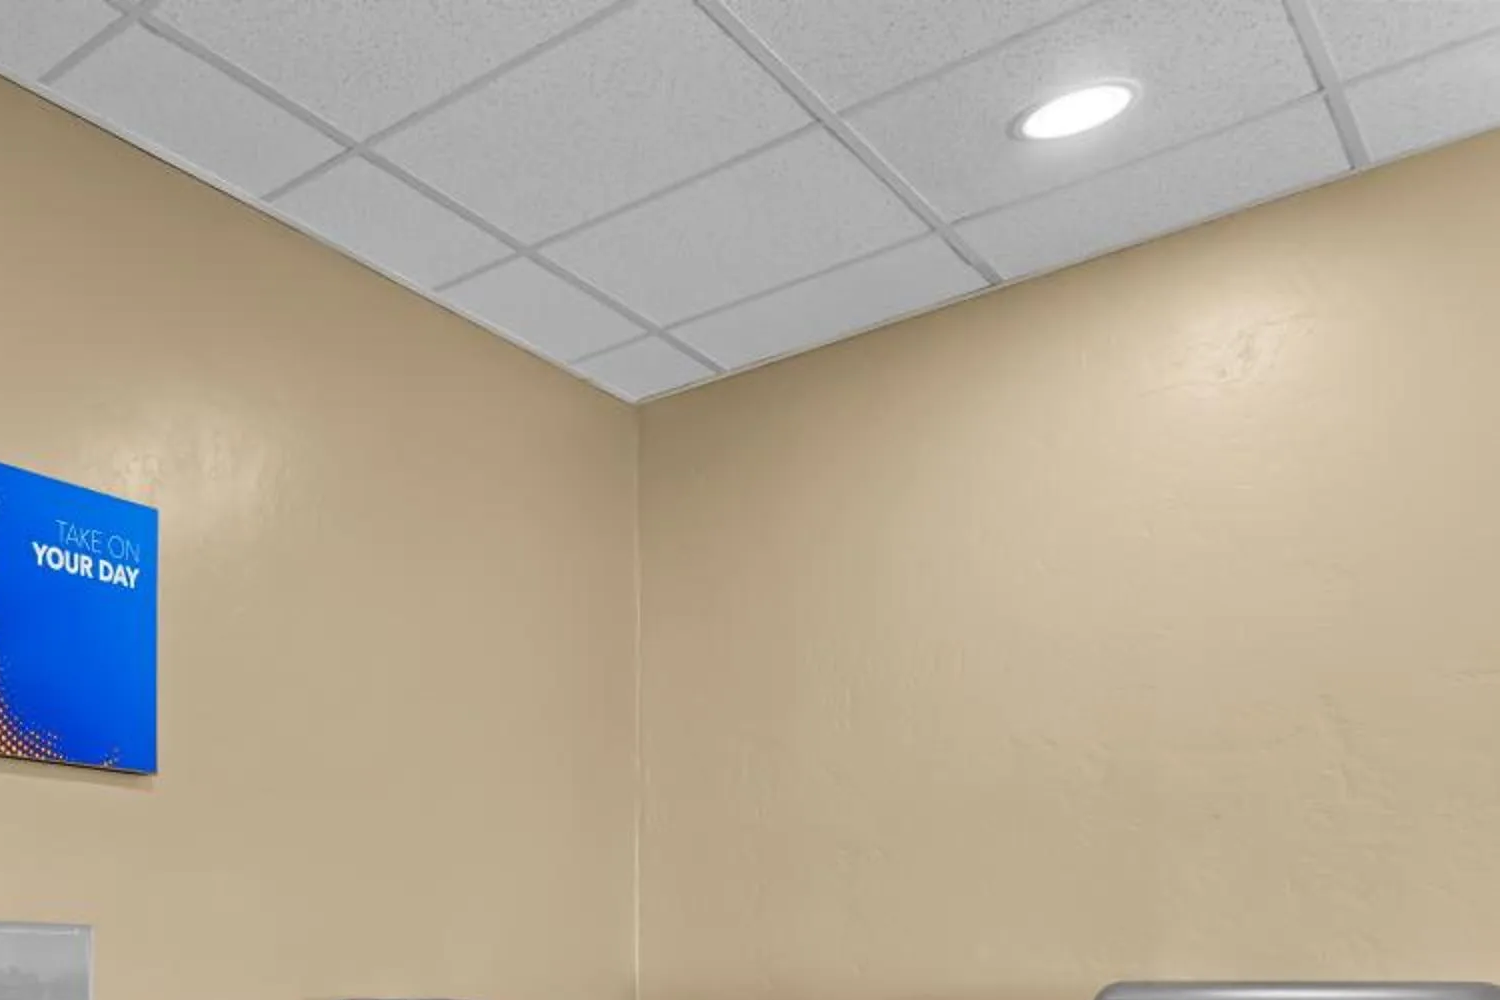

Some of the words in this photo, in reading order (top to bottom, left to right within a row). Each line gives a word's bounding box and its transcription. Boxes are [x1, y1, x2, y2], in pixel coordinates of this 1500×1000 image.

[55, 519, 102, 554] TAKE
[107, 534, 140, 563] ON
[31, 541, 94, 579] YOUR
[99, 559, 140, 589] DAY
